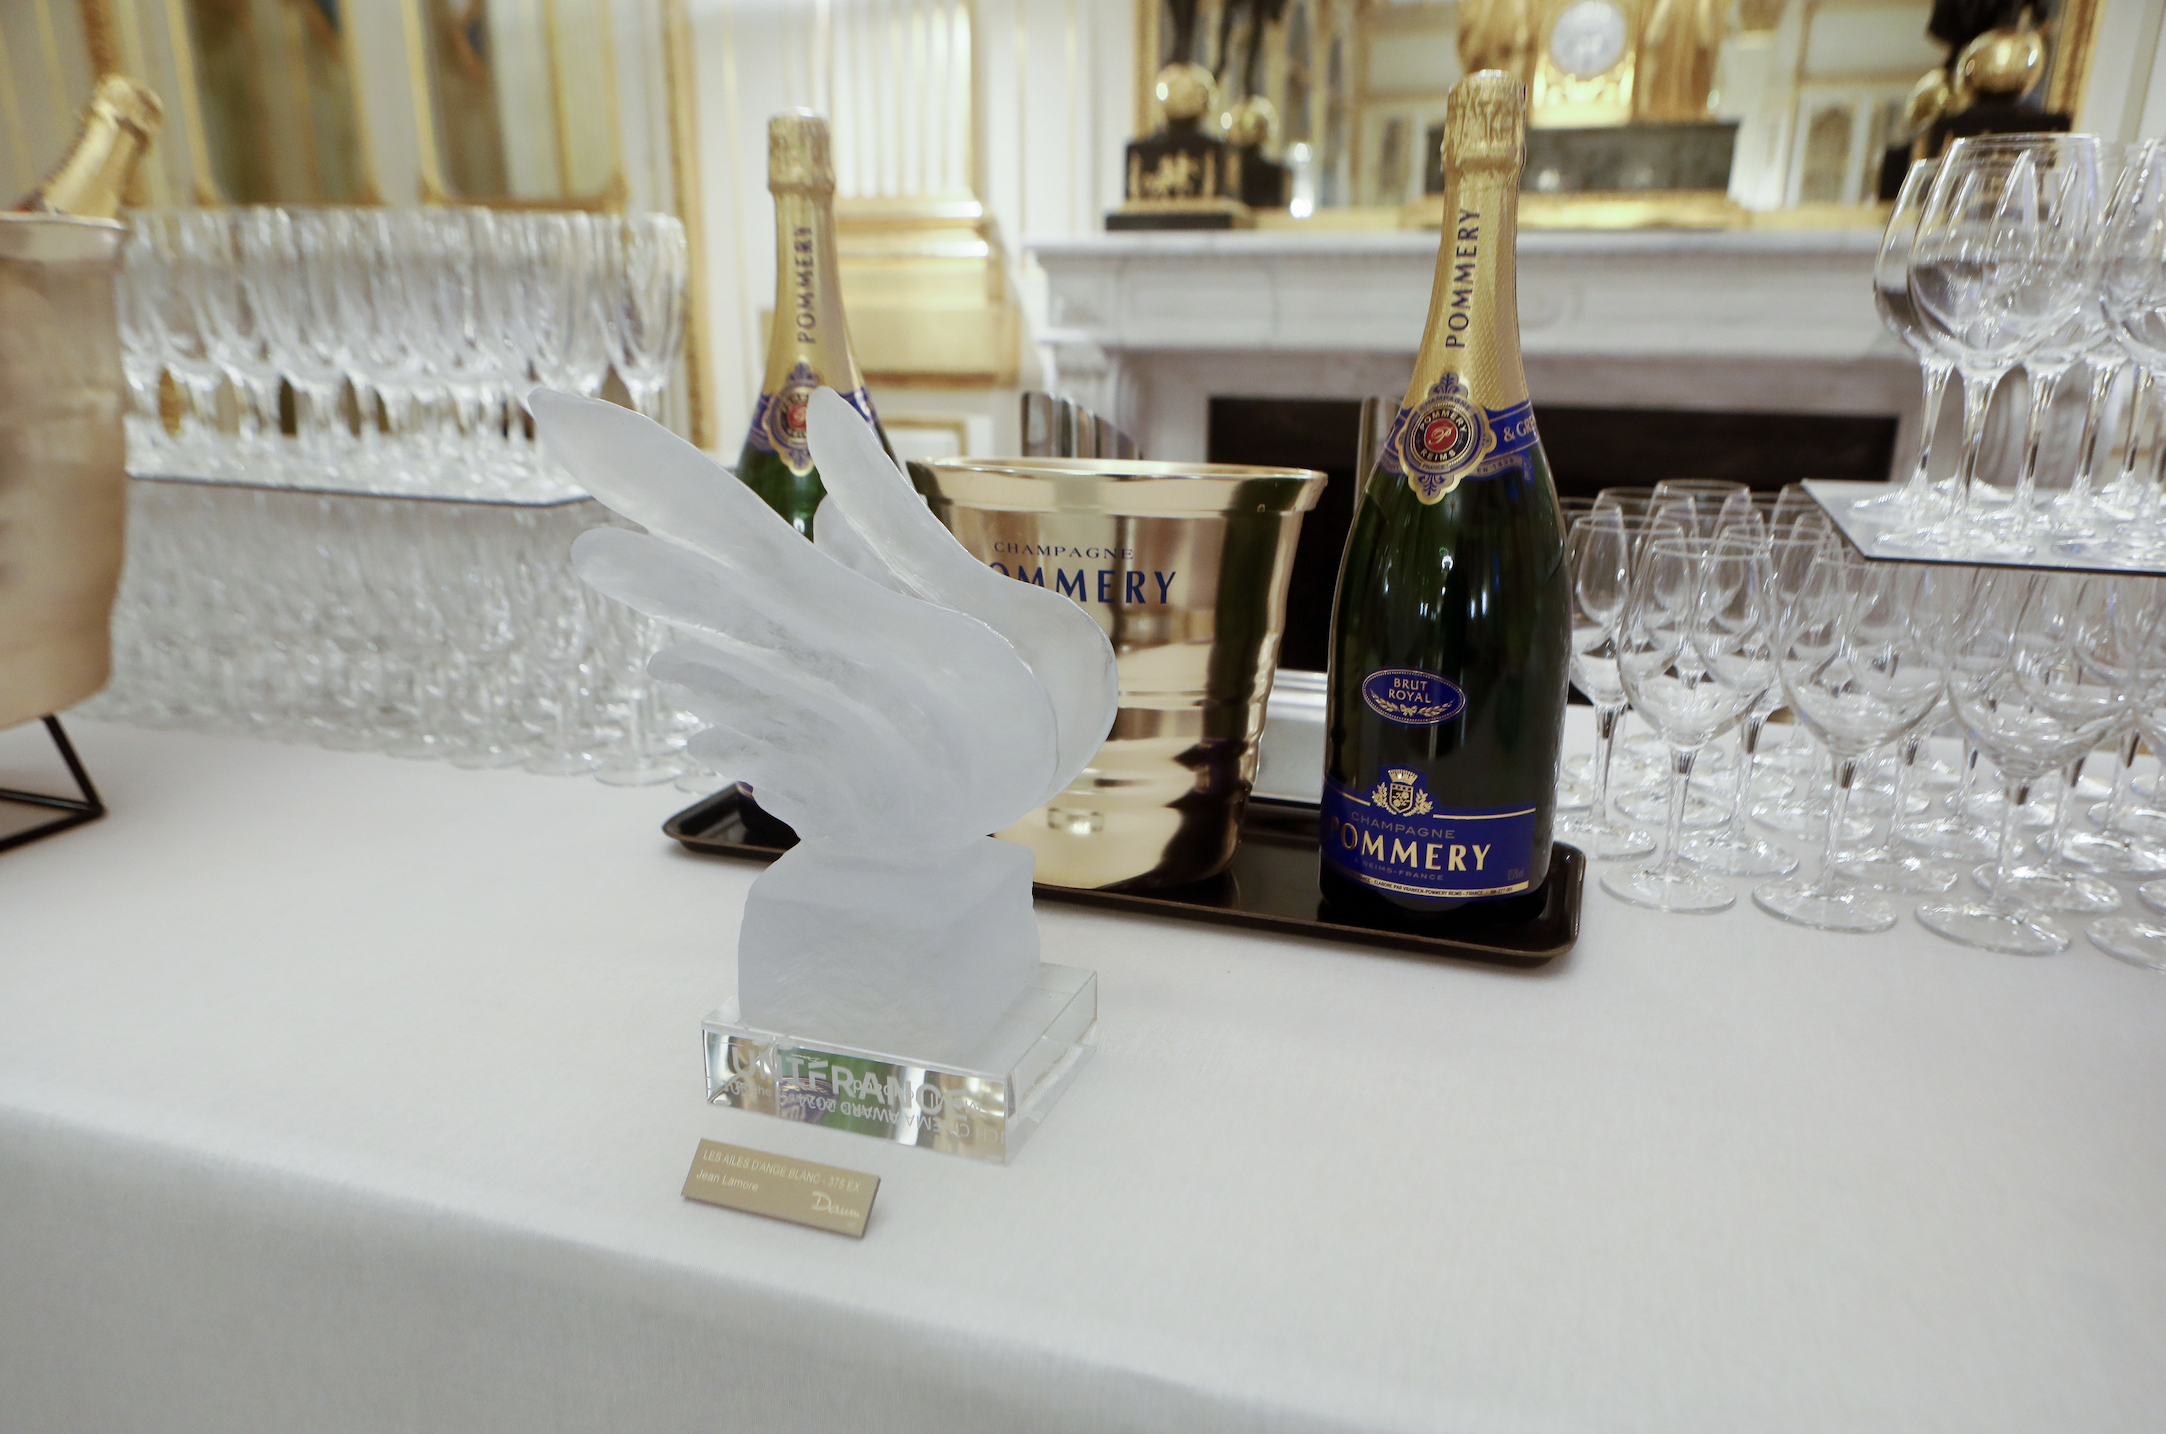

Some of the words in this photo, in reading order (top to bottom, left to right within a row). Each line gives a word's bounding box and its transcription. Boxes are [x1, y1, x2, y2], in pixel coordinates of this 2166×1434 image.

[797, 226, 818, 344] POMMERY
[1445, 207, 1481, 348] POMMERY
[1419, 409, 1468, 431] POMMERY
[1503, 426, 1516, 442] &
[1420, 448, 1457, 462] REIMS
[994, 541, 1134, 560] CHAMPAGNE
[1393, 677, 1428, 691] BRUT
[1388, 688, 1432, 704] ROYAL
[1351, 811, 1456, 839] CHAMPAGNE
[696, 1169, 720, 1184] Jean
[722, 1173, 759, 1192] Lamore
[702, 1149, 722, 1164] LES
[722, 1153, 750, 1170] AILES
[751, 1159, 786, 1178] D'ANGE
[788, 1168, 820, 1185] BLANC
[846, 1180, 861, 1193] EX
